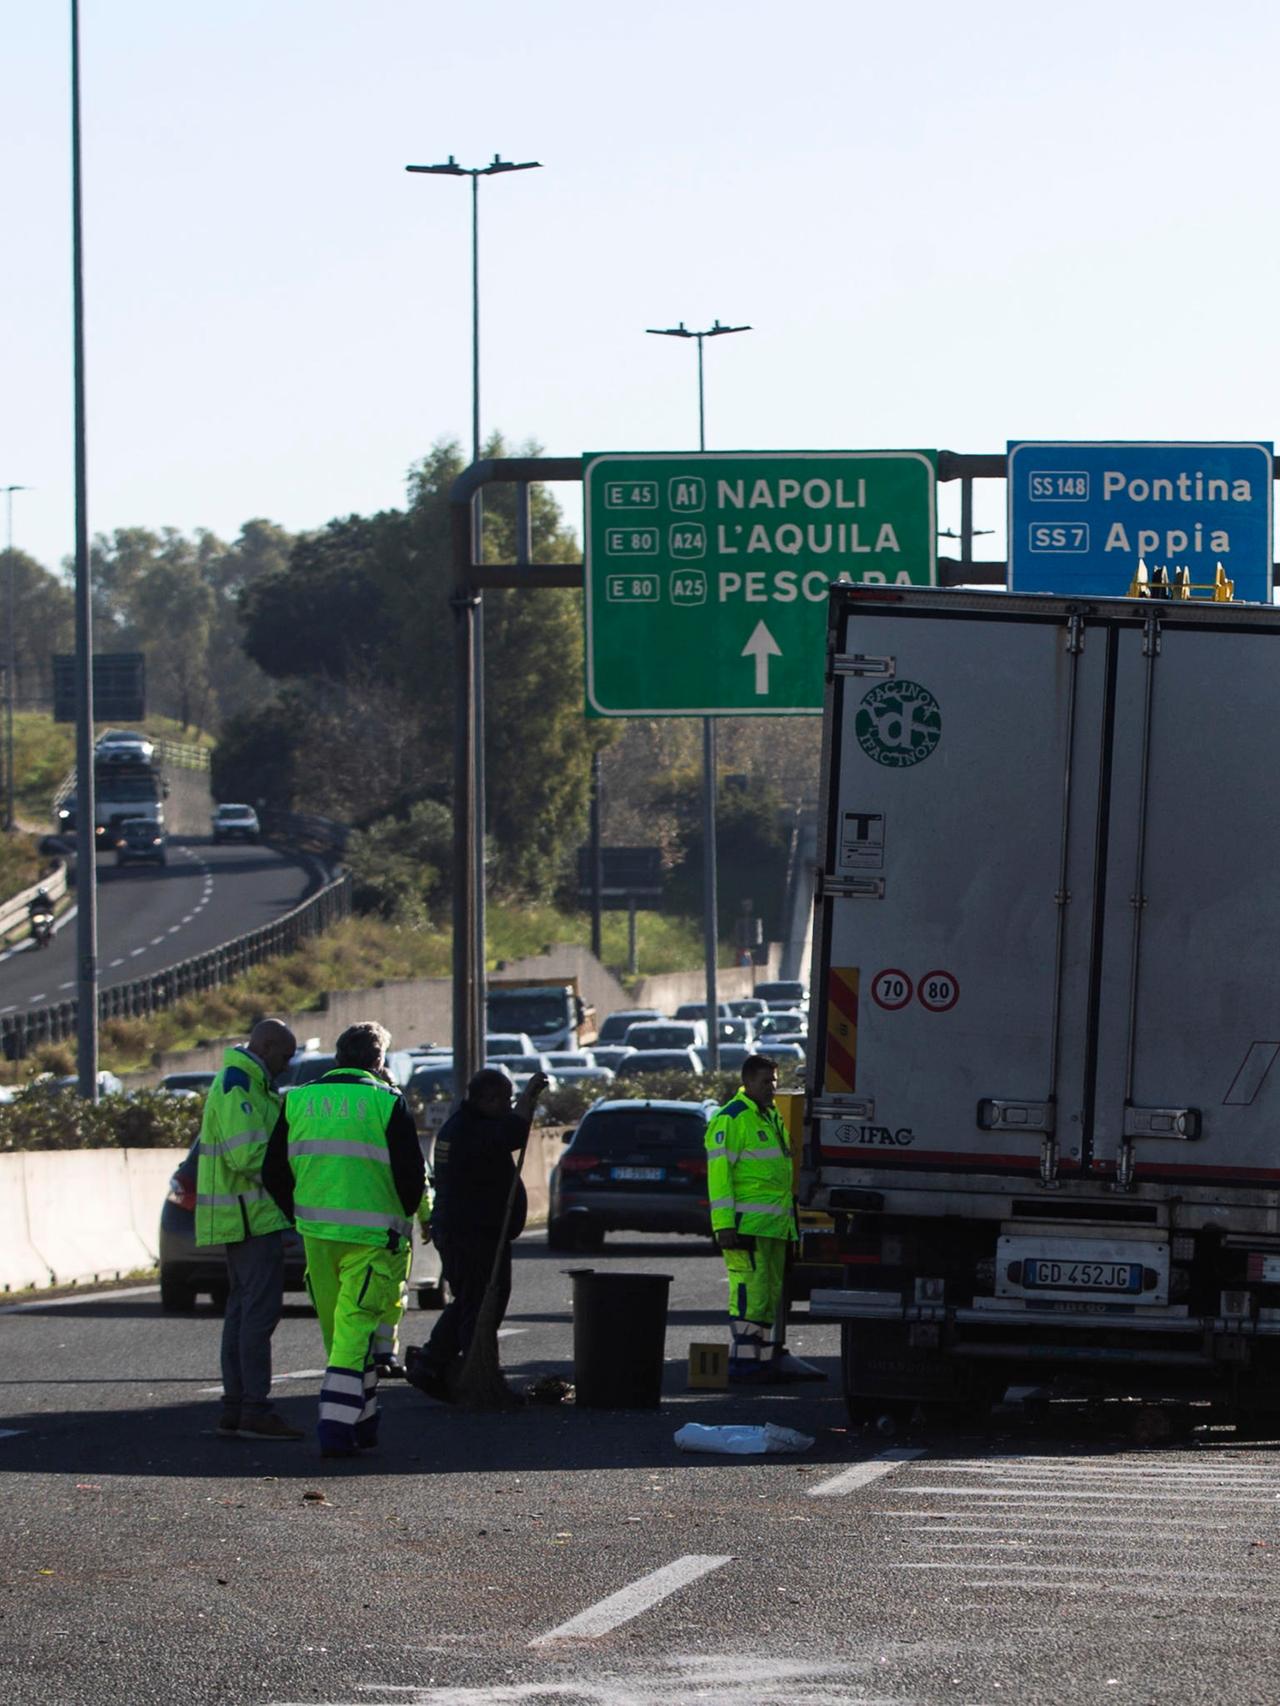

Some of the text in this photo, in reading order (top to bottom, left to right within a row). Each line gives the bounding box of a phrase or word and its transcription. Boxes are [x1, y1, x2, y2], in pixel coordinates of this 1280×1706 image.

[631, 487, 651, 502] 45
[676, 483, 697, 505] A1
[717, 479, 865, 508] NAPOLI
[1033, 472, 1252, 501] SS 148 Pontina
[631, 534, 652, 549] 80
[674, 533, 701, 549] A24
[718, 524, 900, 555] L'AQUILA
[1035, 522, 1230, 558] SS 7 Appia
[632, 580, 652, 595] 80
[674, 580, 703, 596] A25
[845, 813, 882, 840] T
[884, 981, 903, 997] 70
[929, 982, 949, 999] 80
[304, 1096, 368, 1121] ANAS
[859, 1126, 912, 1146] IFAC
[1038, 1263, 1127, 1287] GD 452JG
